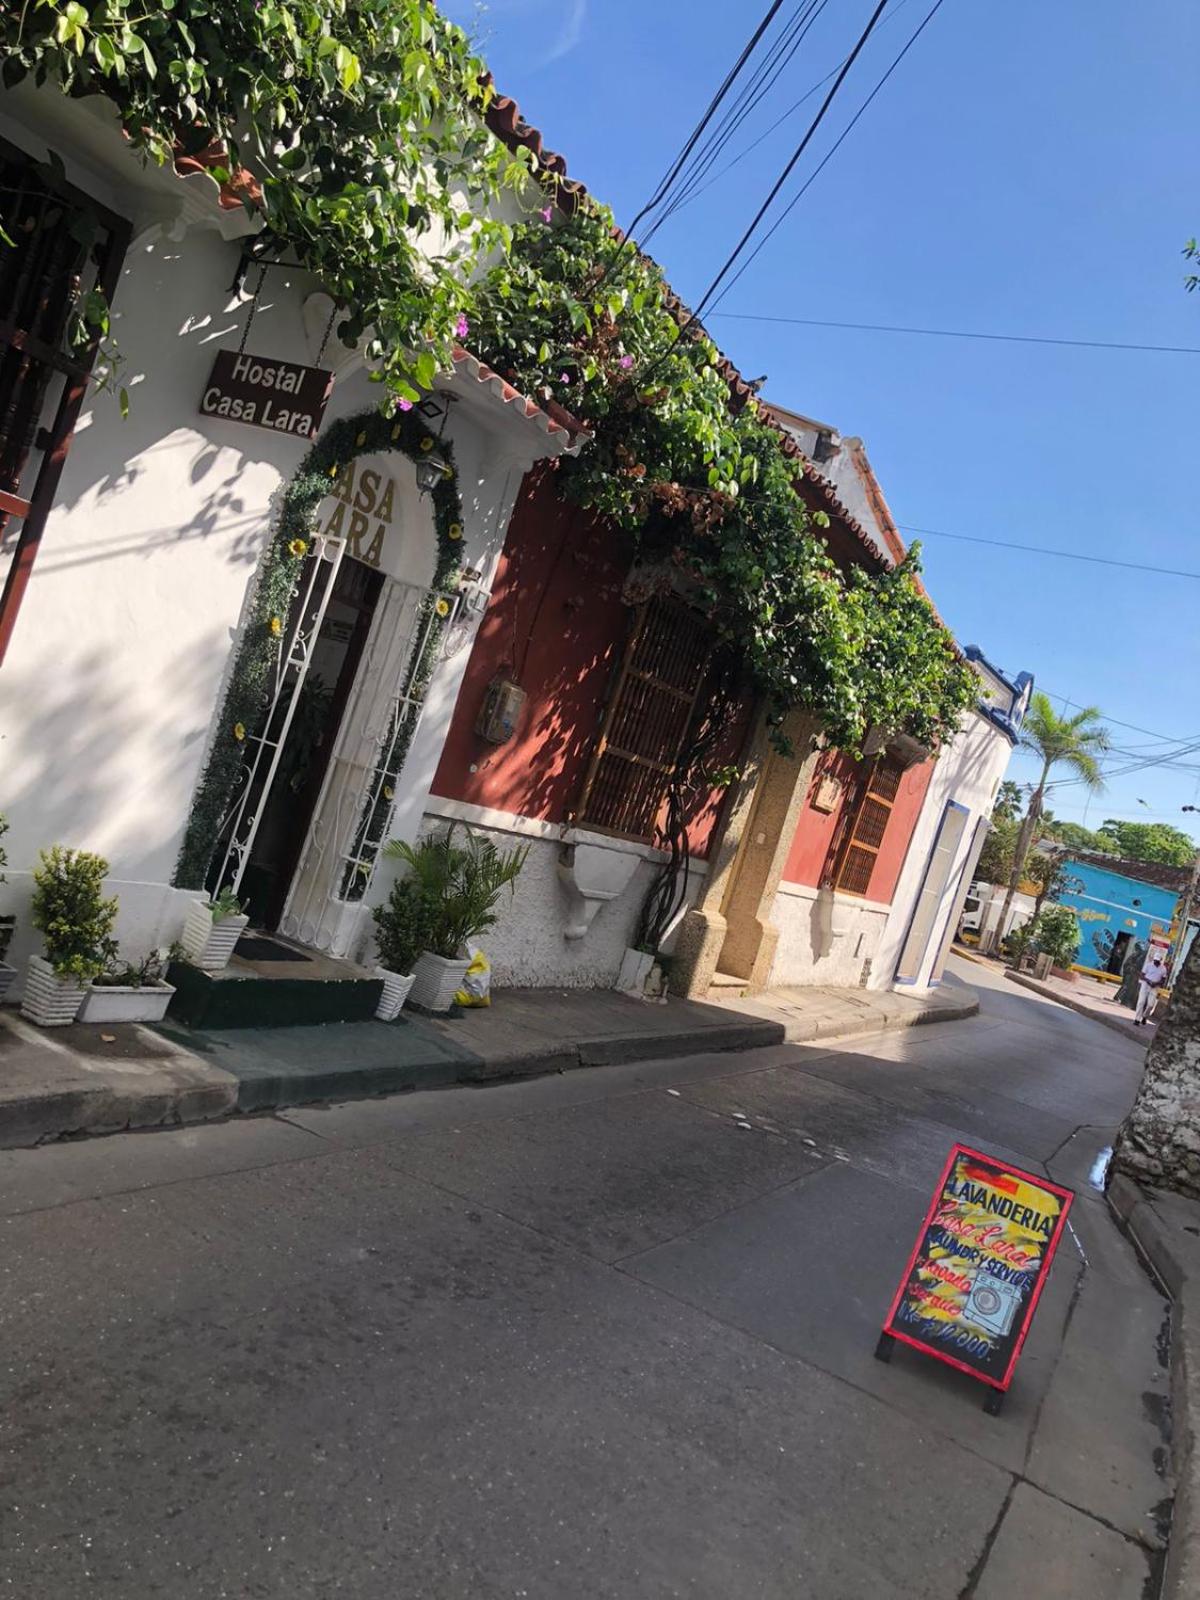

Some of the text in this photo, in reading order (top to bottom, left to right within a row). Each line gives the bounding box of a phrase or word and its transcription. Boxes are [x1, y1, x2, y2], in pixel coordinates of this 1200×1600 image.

[231, 356, 306, 395] Hostal
[202, 387, 312, 435] Casa Lara
[331, 461, 395, 524] ASA
[318, 502, 386, 567] ARA
[931, 1200, 1032, 1268] Casa Lara
[948, 1177, 1053, 1235] LAVANDERIA
